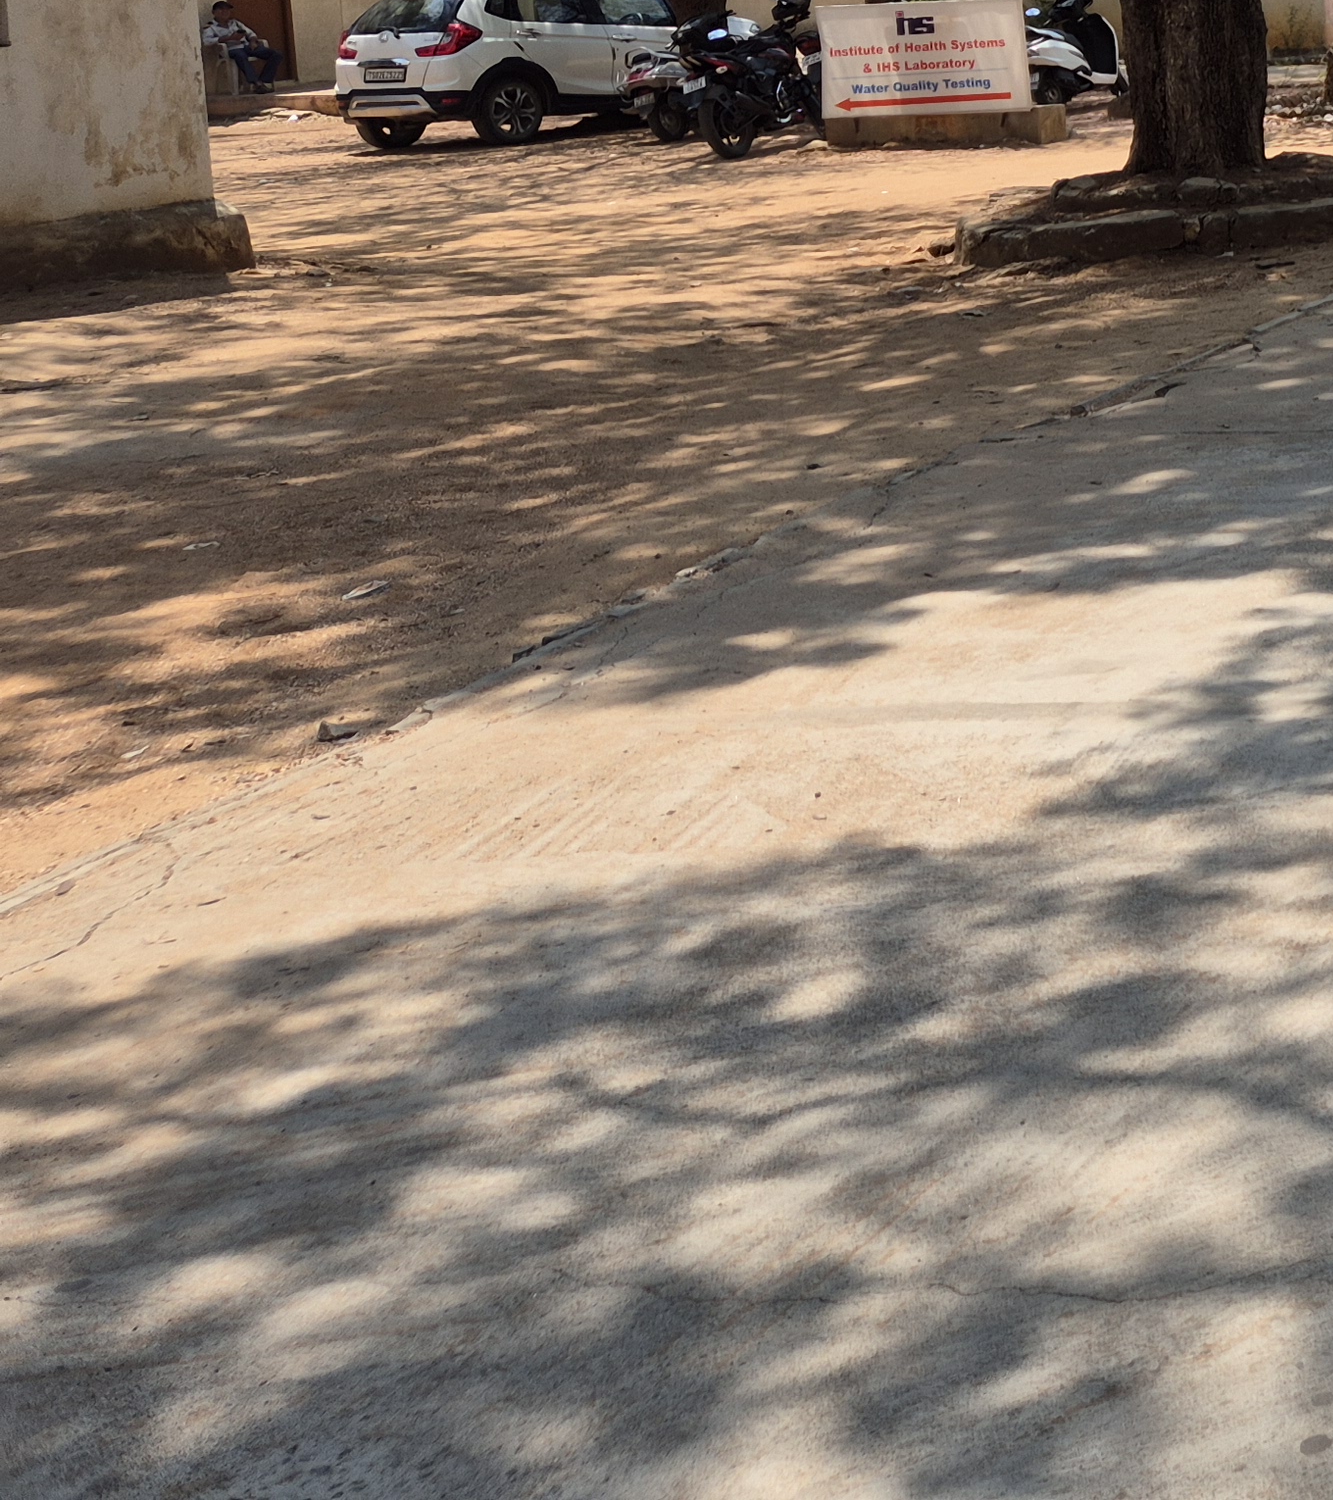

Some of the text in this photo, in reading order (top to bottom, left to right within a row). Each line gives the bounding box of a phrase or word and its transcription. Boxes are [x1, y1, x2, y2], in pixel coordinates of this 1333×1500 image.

[829, 37, 1006, 58] Institute of Health Systems
[863, 58, 976, 73] & IHS Laboratory
[851, 77, 992, 95] Water Quality Testing
